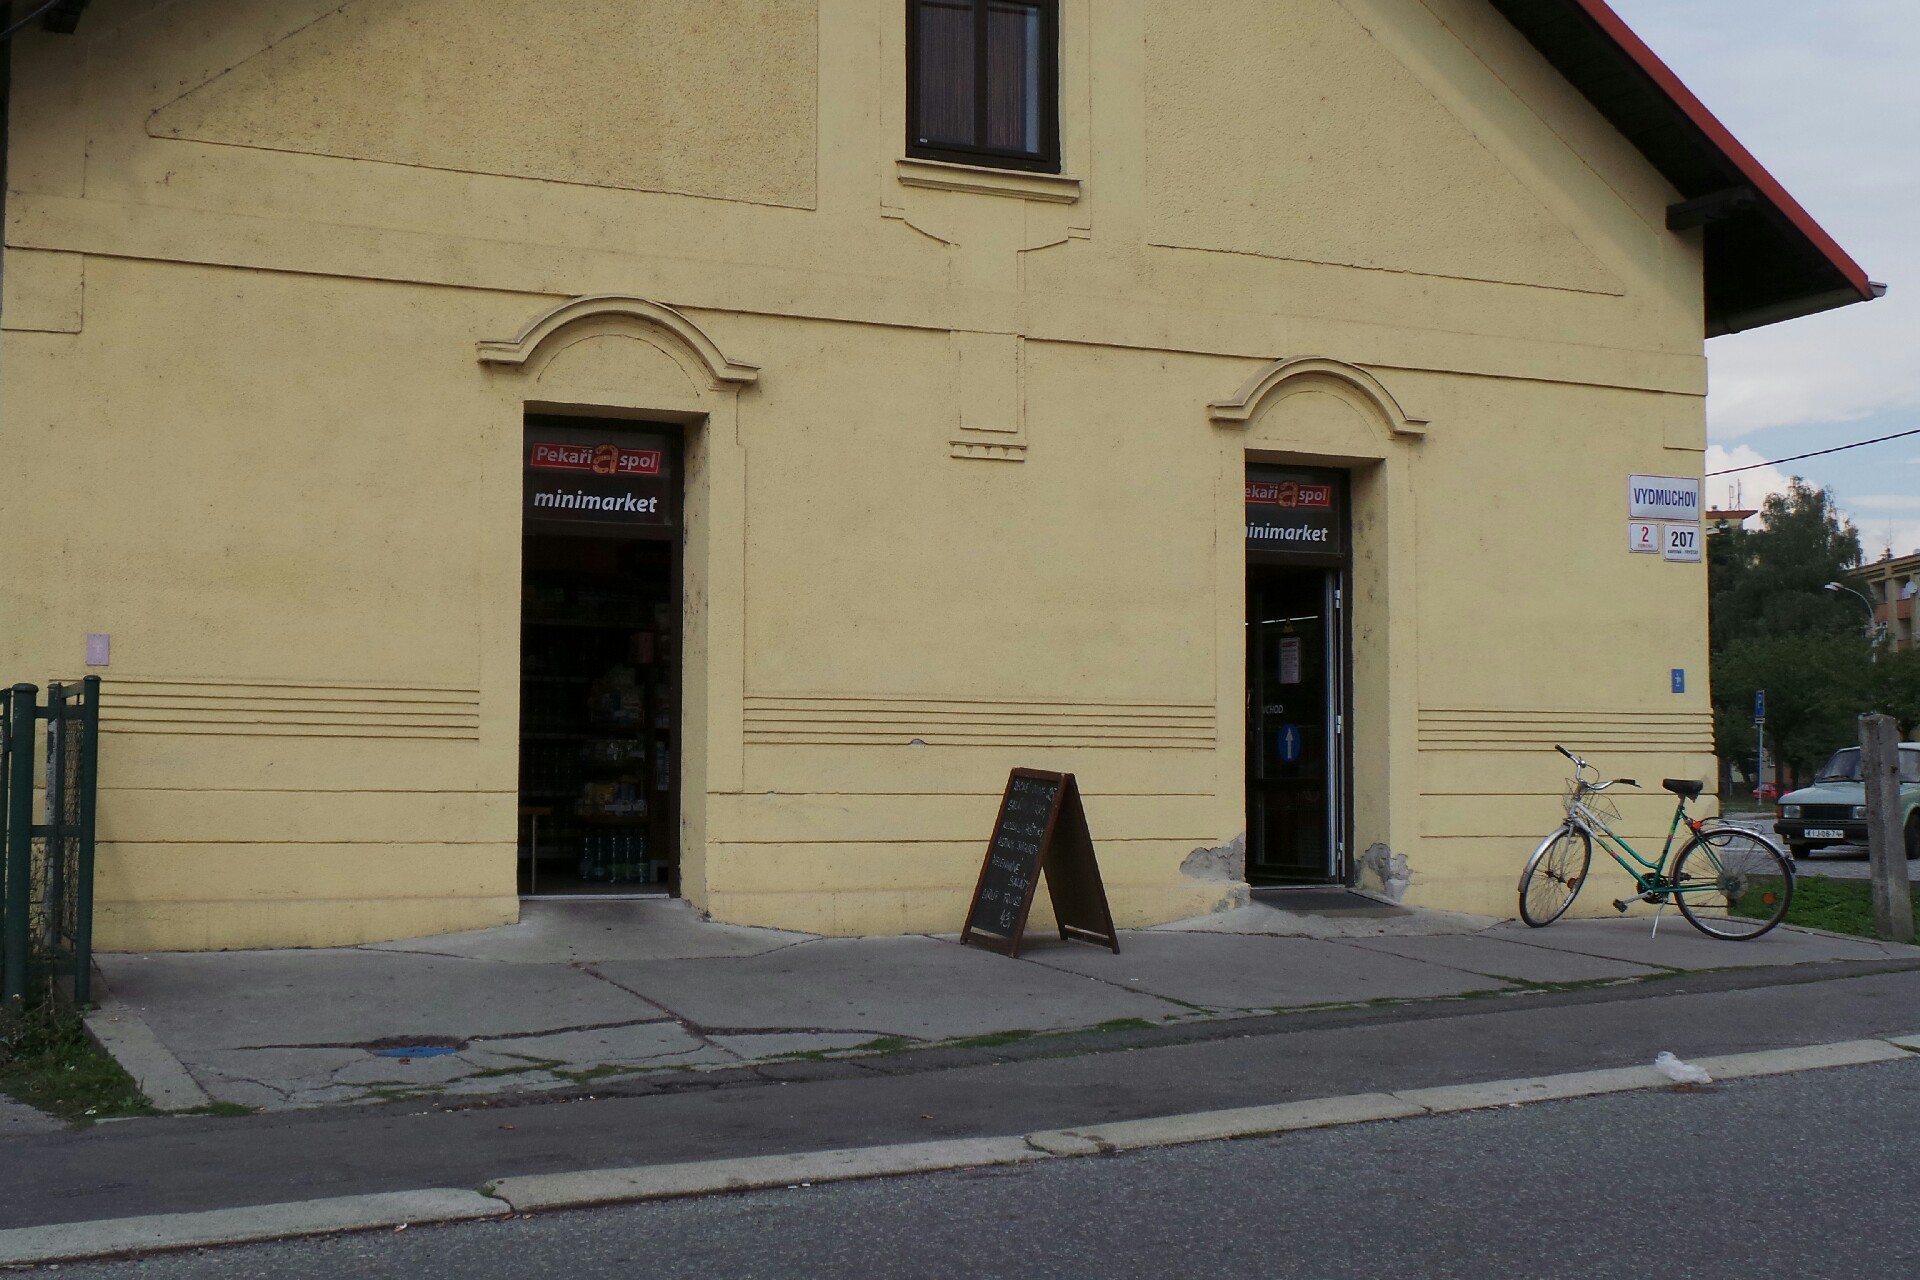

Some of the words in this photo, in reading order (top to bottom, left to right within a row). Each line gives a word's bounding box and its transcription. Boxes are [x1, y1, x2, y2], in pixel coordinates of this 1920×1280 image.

[537, 446, 592, 464] Pekaři
[619, 453, 656, 470] spol
[534, 489, 658, 513] minimarket
[1245, 485, 1278, 499] ekaři
[1299, 488, 1327, 503] spol
[1634, 488, 1696, 507] VYDMUCHOV
[1641, 527, 1649, 543] 2
[1671, 531, 1694, 547] 207
